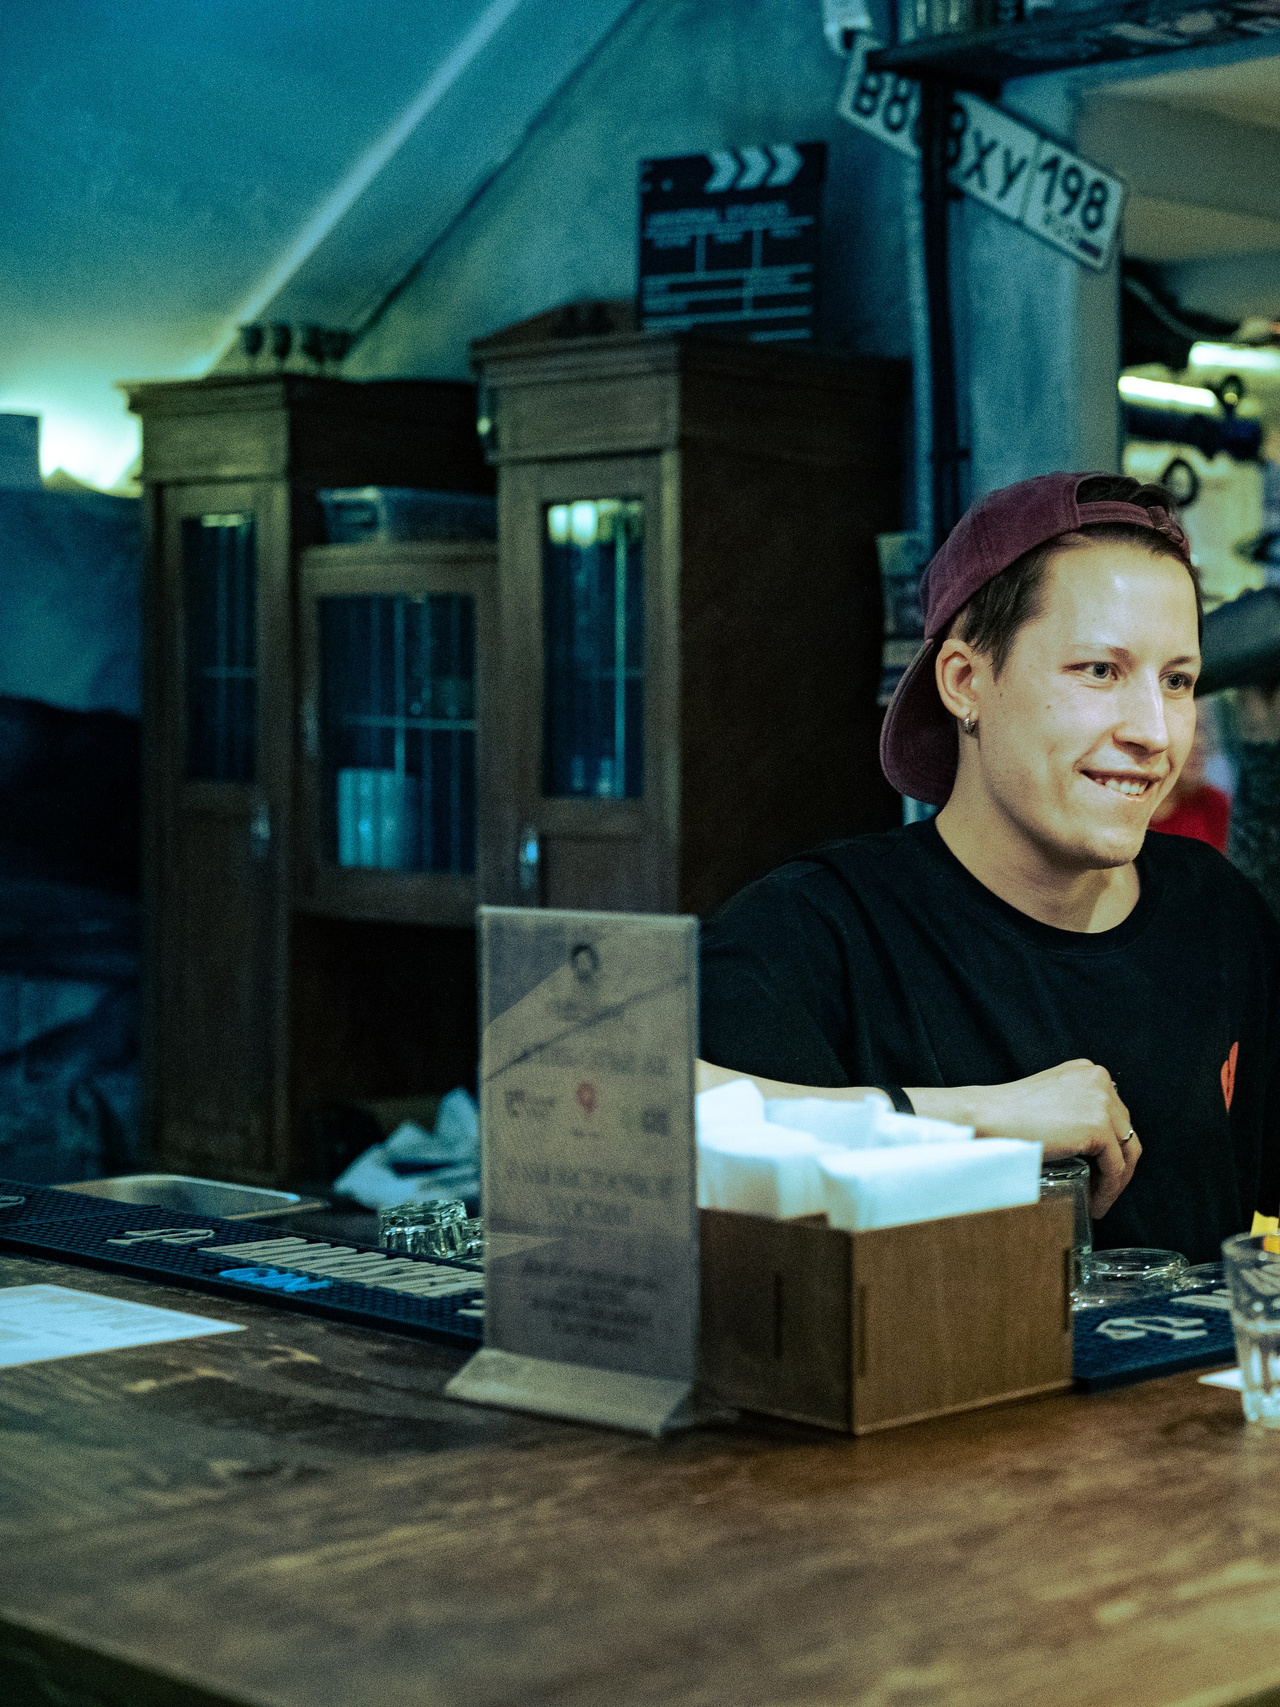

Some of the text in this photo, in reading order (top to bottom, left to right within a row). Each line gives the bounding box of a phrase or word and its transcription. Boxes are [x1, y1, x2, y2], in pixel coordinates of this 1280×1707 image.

[1037, 156, 1110, 230] 198
[197, 1236, 485, 1298] BARRISTER
[218, 1267, 333, 1293] GIN
